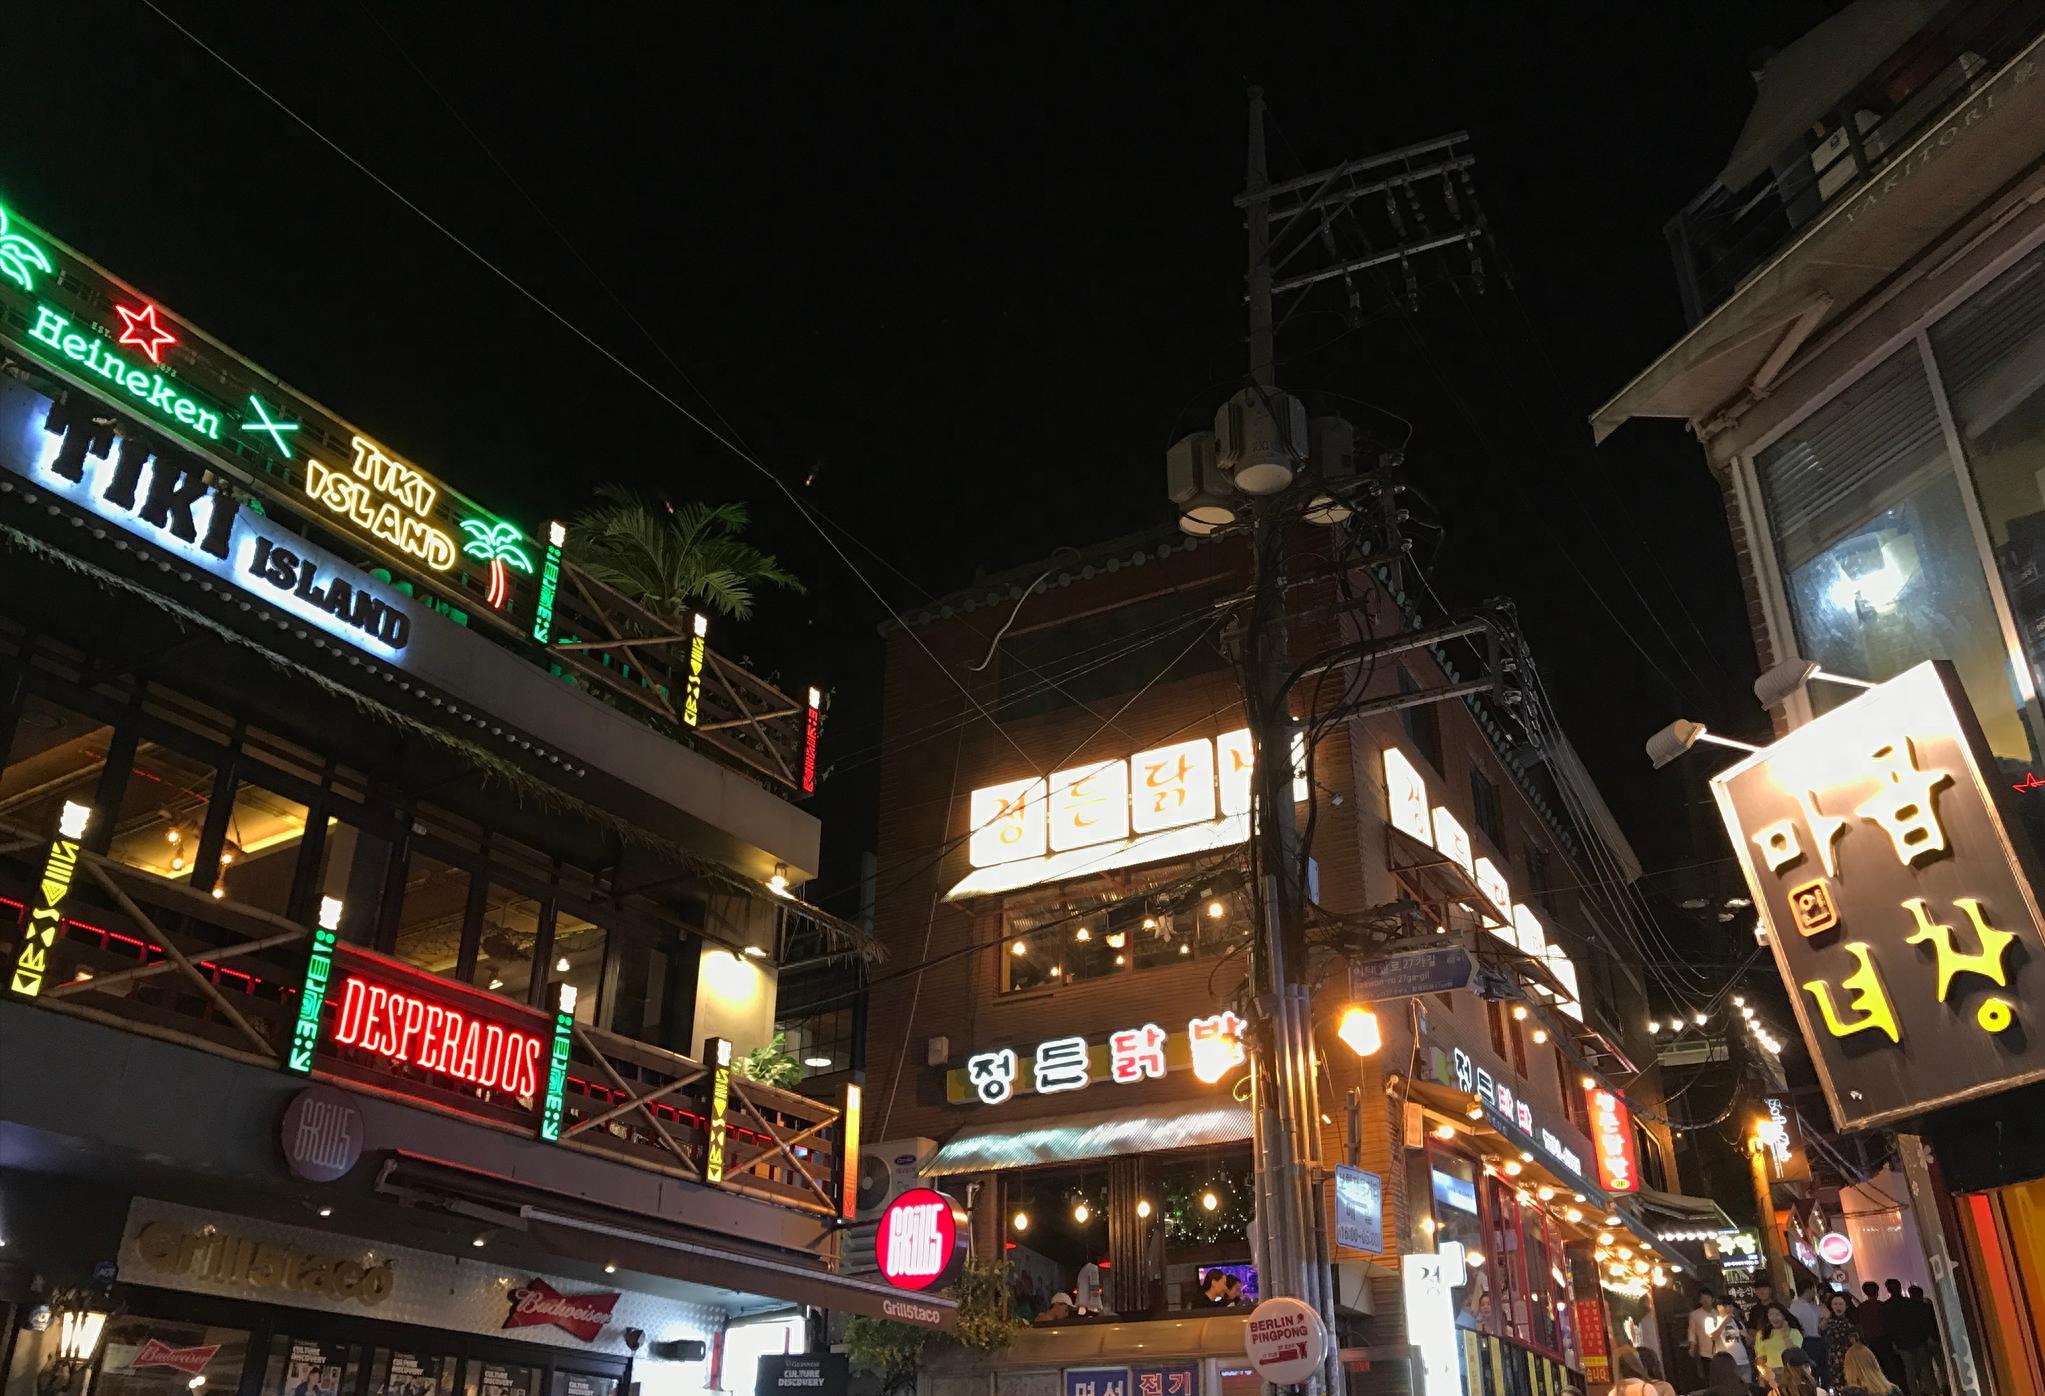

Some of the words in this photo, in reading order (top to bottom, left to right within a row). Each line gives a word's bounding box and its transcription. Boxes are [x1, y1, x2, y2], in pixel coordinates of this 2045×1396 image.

[29, 306, 219, 440] Heineken
[352, 435, 437, 518] TIKI
[43, 400, 241, 561] TIKI
[248, 535, 411, 650] ISLAND
[305, 459, 457, 571] ISLAND
[335, 976, 542, 1099] DESPERADOS
[515, 1288, 613, 1323] Budweiser
[1250, 1315, 1294, 1333] BERLIN
[1252, 1325, 1309, 1345] PINGPONG
[777, 1377, 825, 1387] DISCOVERY
[783, 1369, 821, 1378] CULTURE
